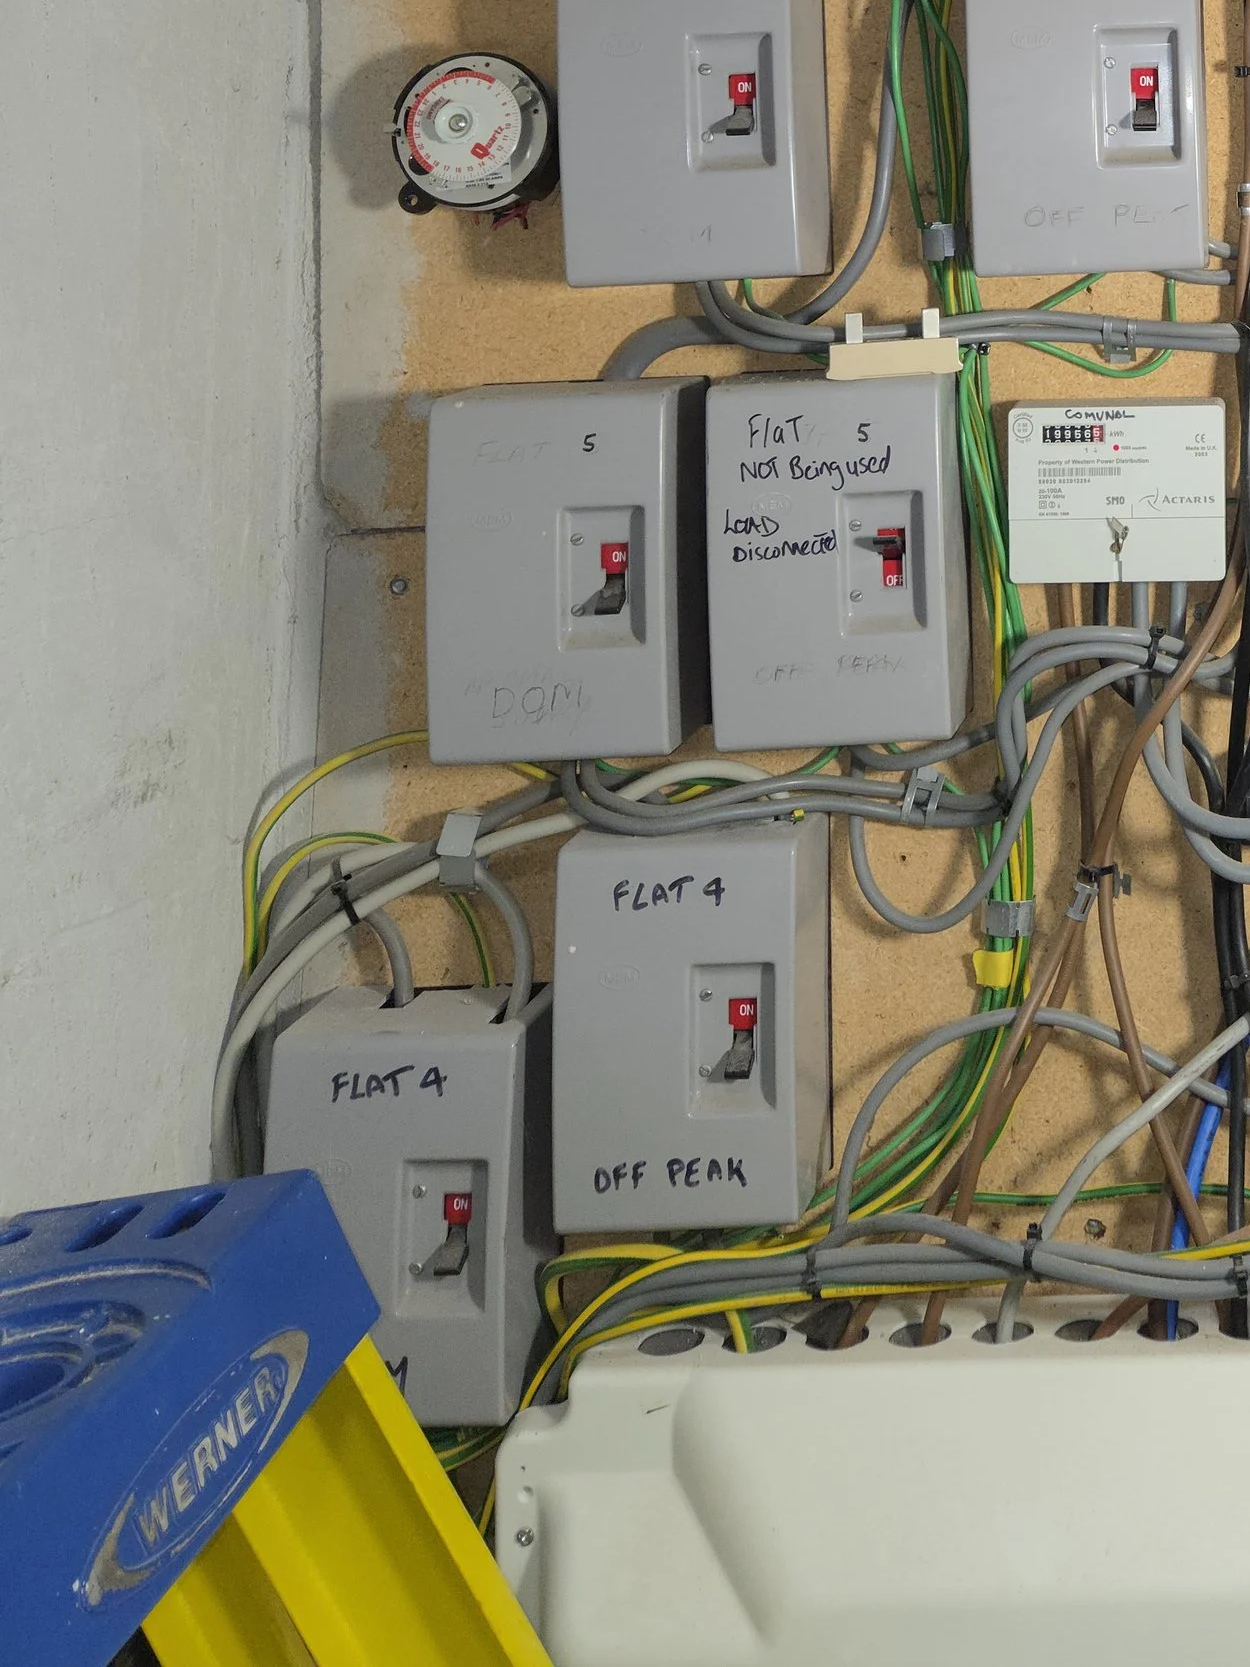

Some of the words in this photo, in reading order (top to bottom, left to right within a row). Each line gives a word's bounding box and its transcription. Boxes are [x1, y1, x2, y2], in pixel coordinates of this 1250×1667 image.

[737, 81, 752, 93] ON
[1139, 75, 1154, 87] ON
[583, 433, 596, 452] 5
[857, 423, 871, 443] 5
[740, 461, 778, 482] NOT
[790, 455, 843, 491] Being
[846, 446, 891, 476] used
[612, 550, 627, 563] ON
[612, 877, 698, 911] FLAT
[702, 875, 726, 908] 4
[739, 1004, 755, 1017] ON
[331, 1066, 414, 1104] FLAT
[420, 1065, 448, 1097] 4
[593, 1157, 648, 1194] OFF
[667, 1156, 748, 1188] PEAK
[453, 1197, 469, 1210] ON
[137, 1364, 286, 1549] WERNER
